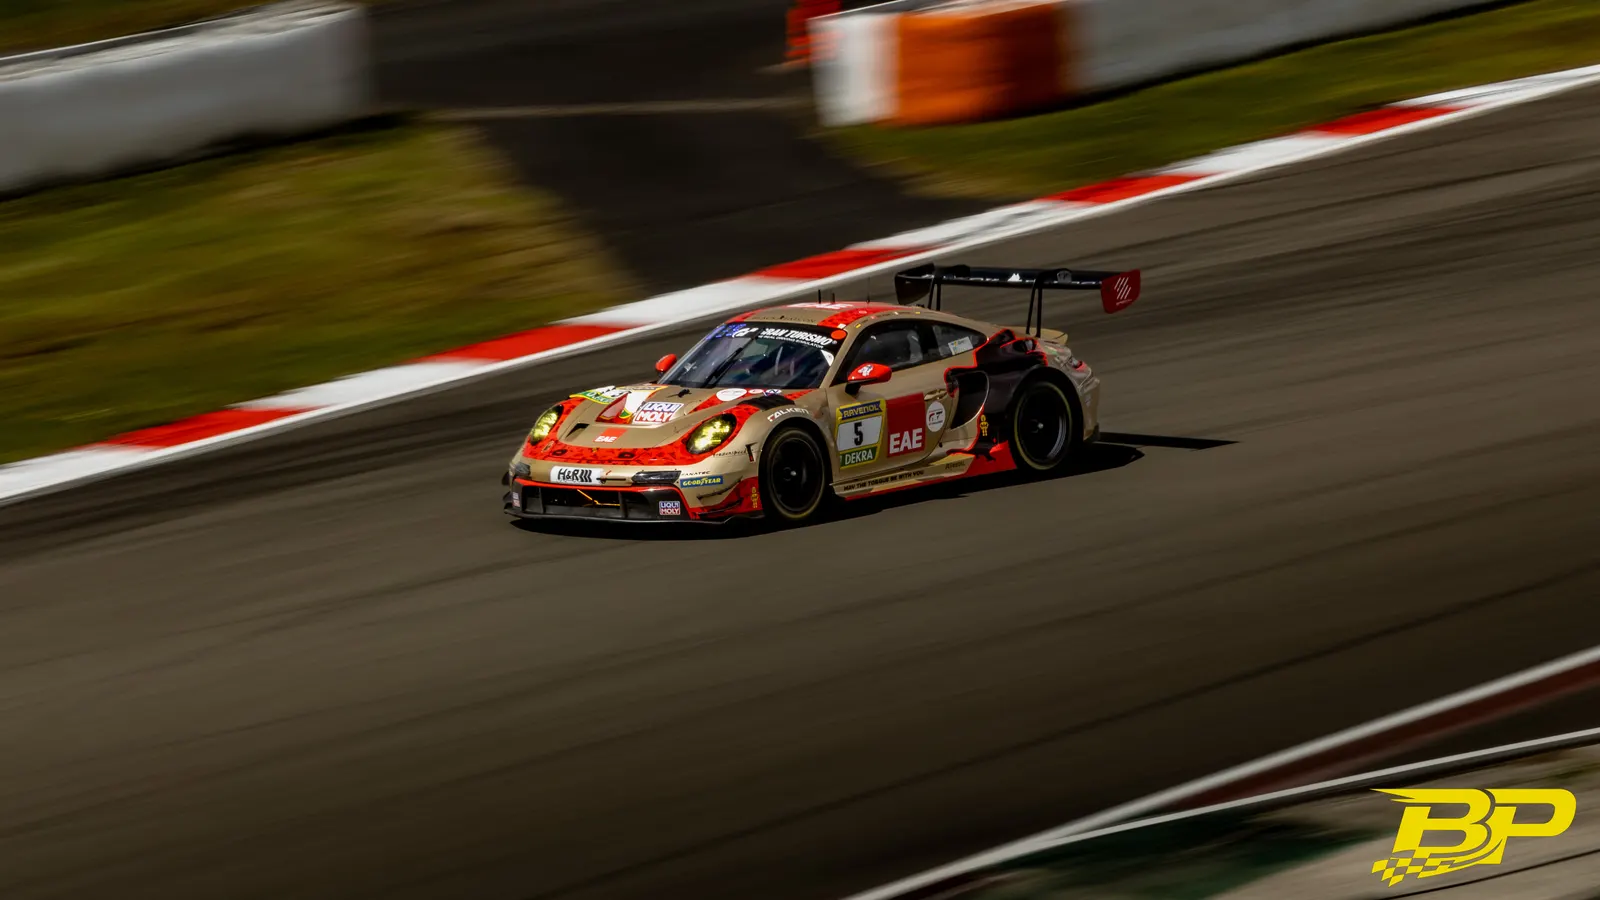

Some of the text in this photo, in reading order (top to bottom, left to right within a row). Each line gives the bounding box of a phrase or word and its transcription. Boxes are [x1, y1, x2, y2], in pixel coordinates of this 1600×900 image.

[643, 402, 682, 412] LIQUI
[767, 407, 809, 422] FALKEN
[843, 403, 880, 418] RAVENOL
[635, 411, 674, 422] MOLY
[594, 435, 618, 443] EAE
[853, 421, 864, 446] 5
[889, 427, 923, 454] EAE
[844, 449, 874, 465] DEKRA
[557, 467, 580, 482] H&R
[683, 477, 721, 486] GOODYEAR
